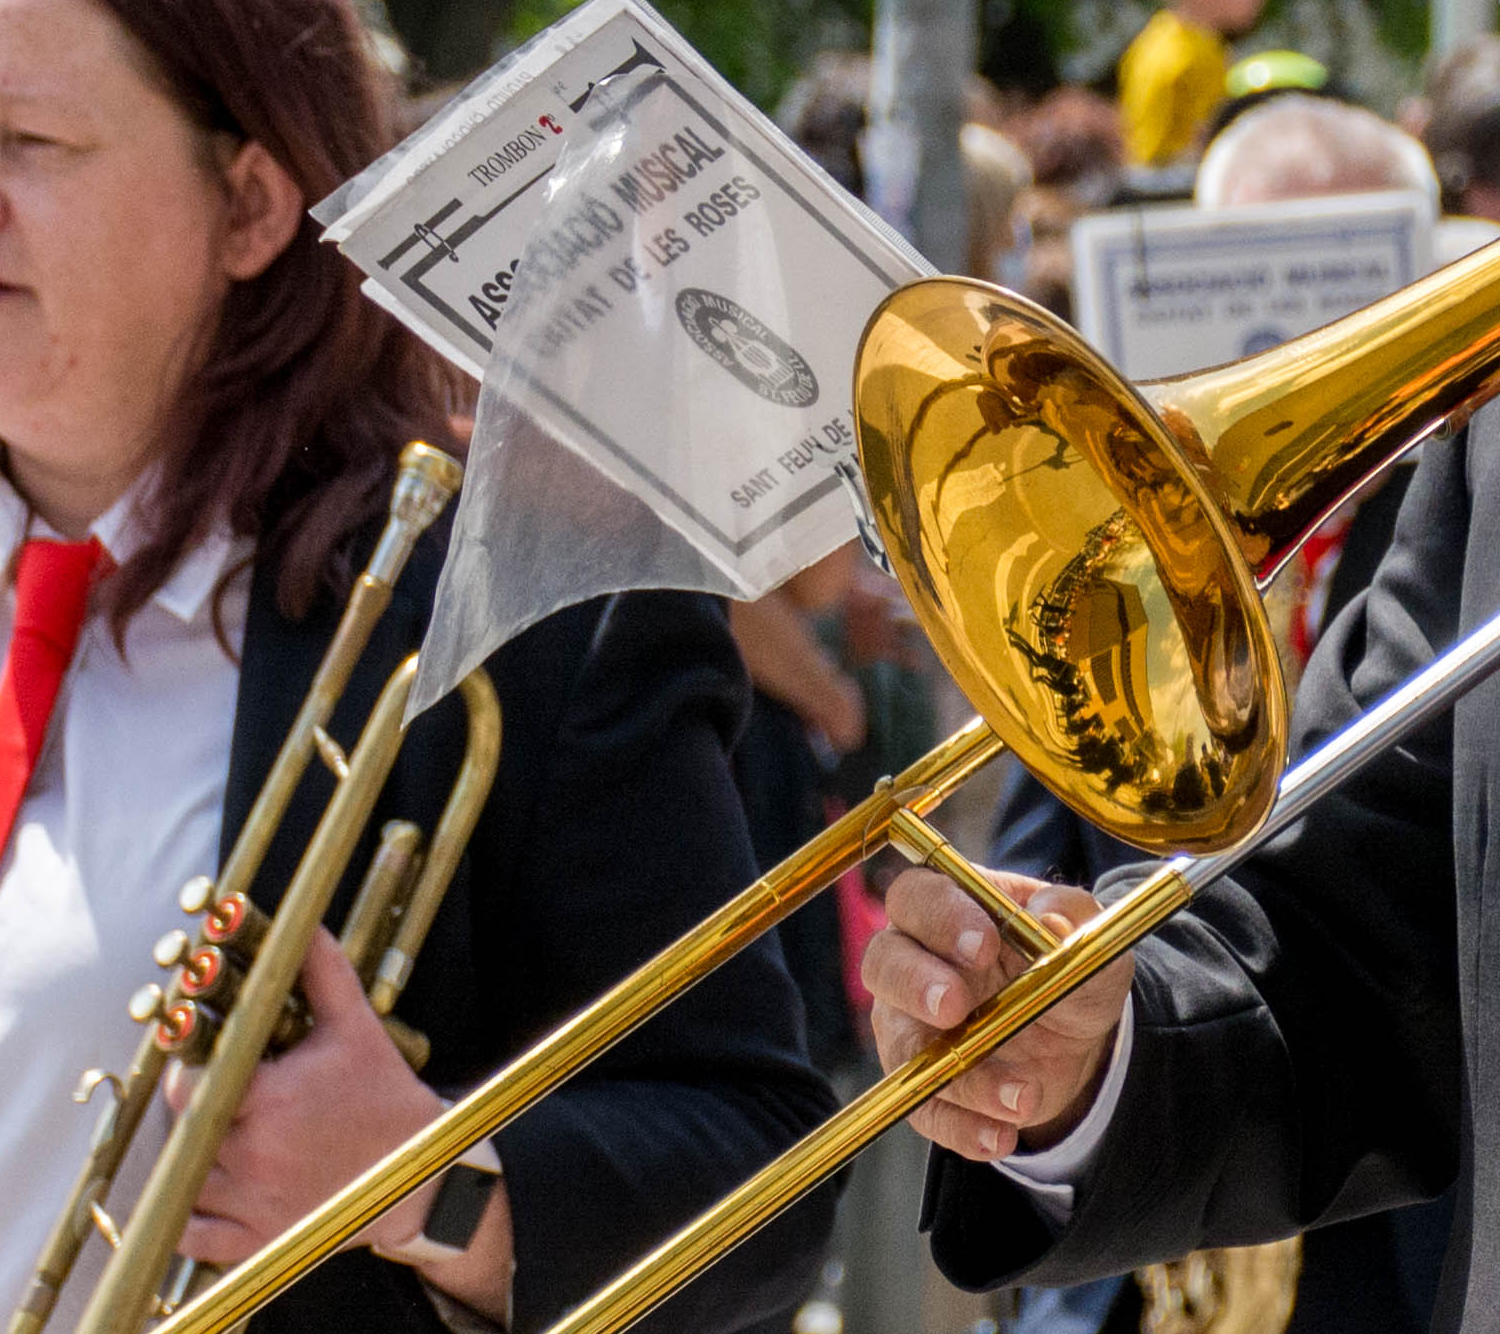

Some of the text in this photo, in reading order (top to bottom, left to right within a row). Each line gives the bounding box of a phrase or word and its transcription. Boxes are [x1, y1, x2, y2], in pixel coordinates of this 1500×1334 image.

[467, 124, 547, 188] TROMBON
[610, 125, 726, 215] MUSICAL
[644, 227, 691, 268] LES
[683, 175, 762, 238] ROSES
[700, 294, 770, 342] MUSICAL
[729, 468, 781, 509] SANT
[821, 418, 852, 445] DE
